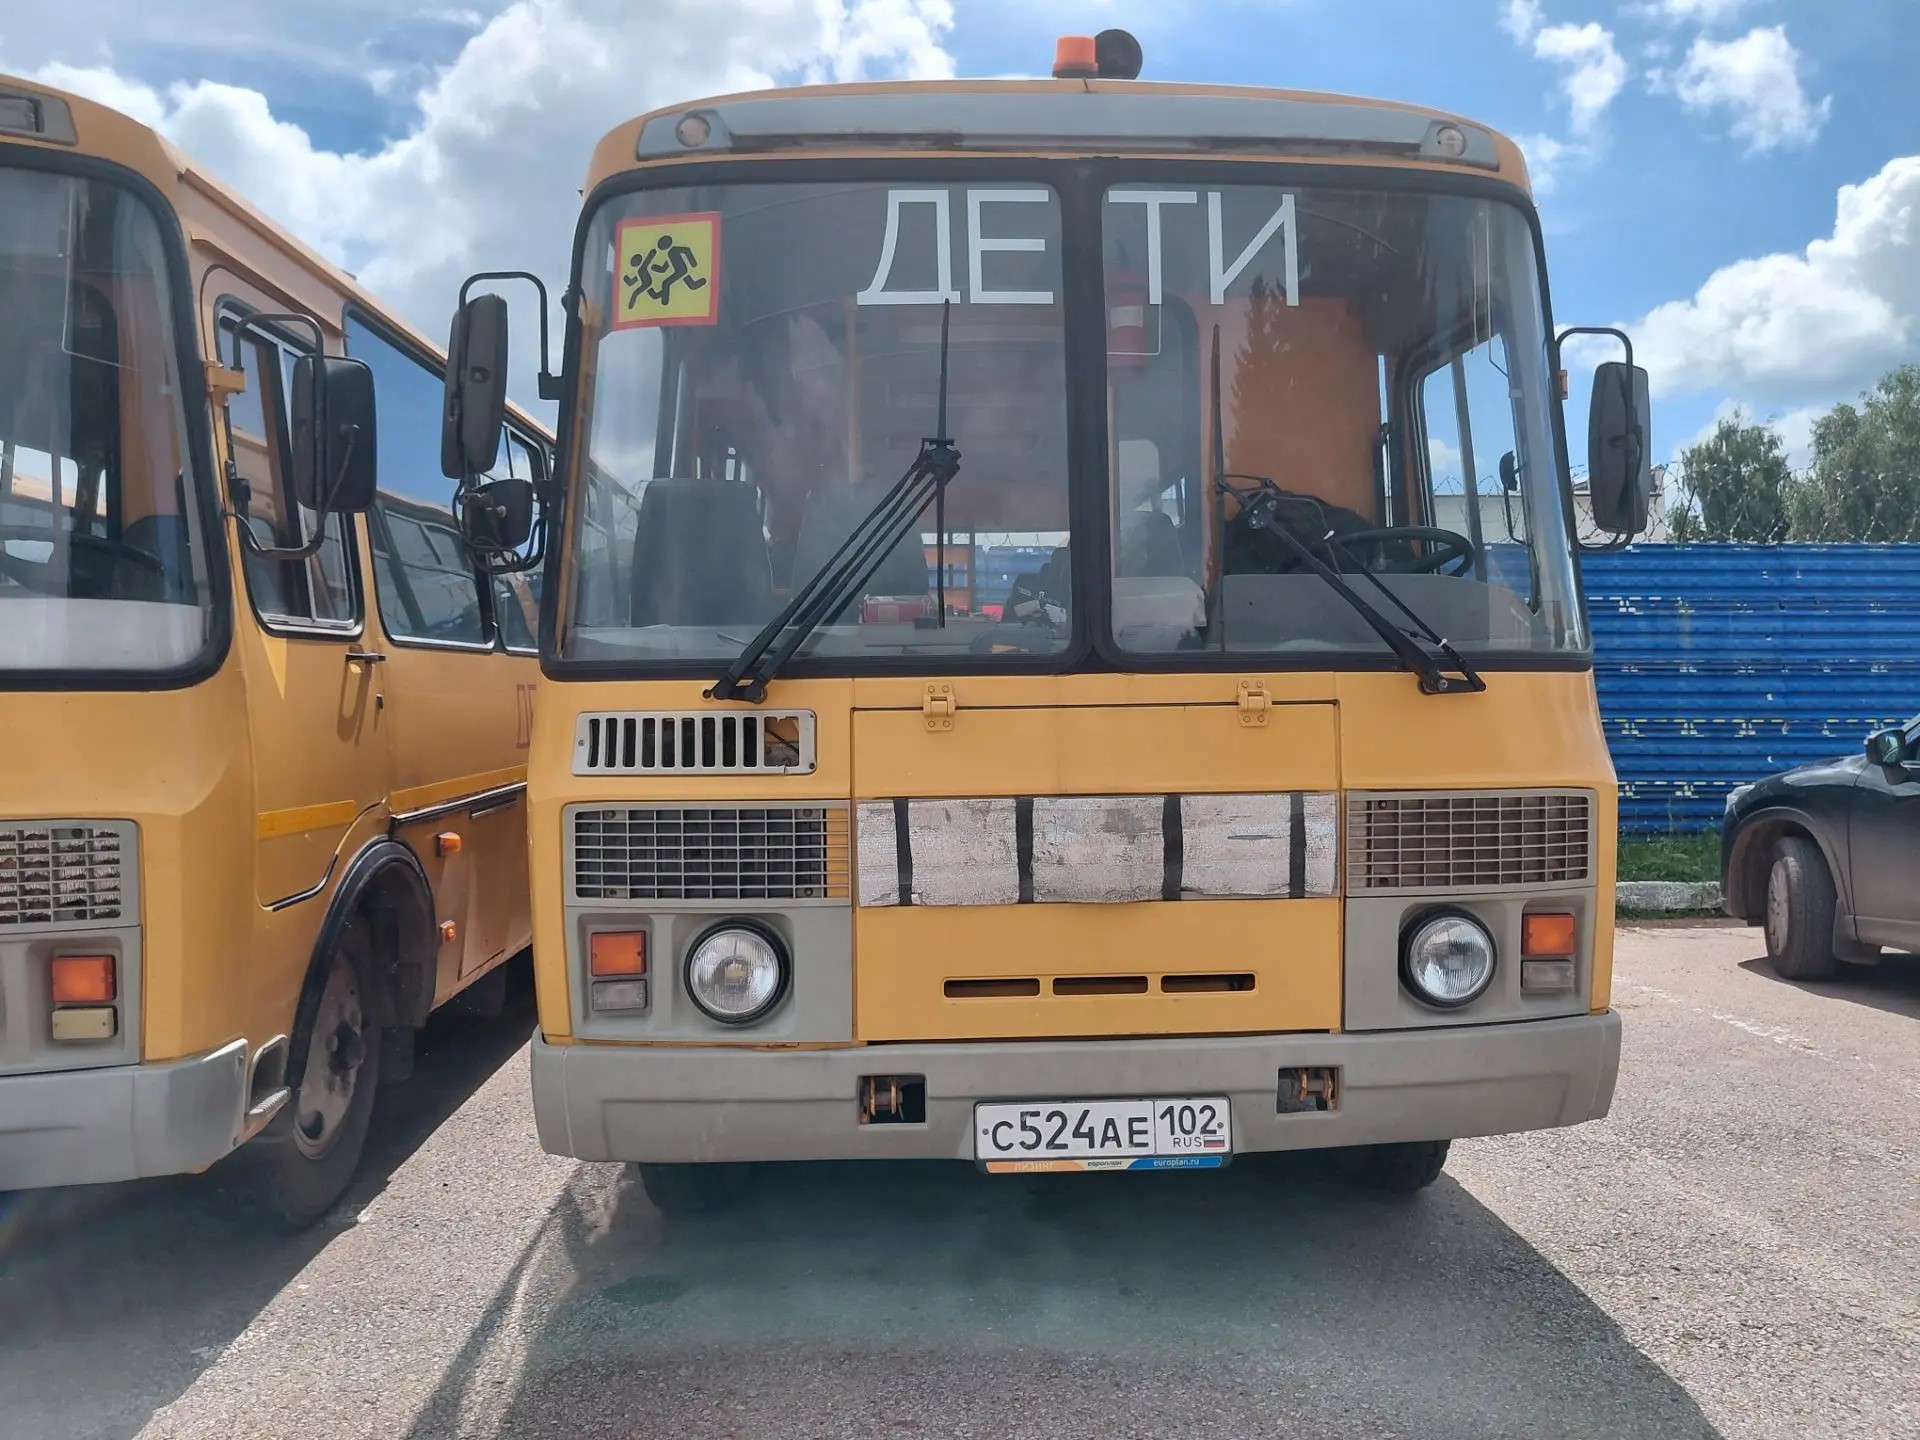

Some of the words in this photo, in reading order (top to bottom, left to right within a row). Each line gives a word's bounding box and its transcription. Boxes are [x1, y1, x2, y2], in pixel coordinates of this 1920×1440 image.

[857, 189, 1299, 306] ДЕТИ
[1159, 1104, 1217, 1136] 102
[1173, 1136, 1202, 1148] RUS
[1153, 1157, 1200, 1168] europlan.ru
